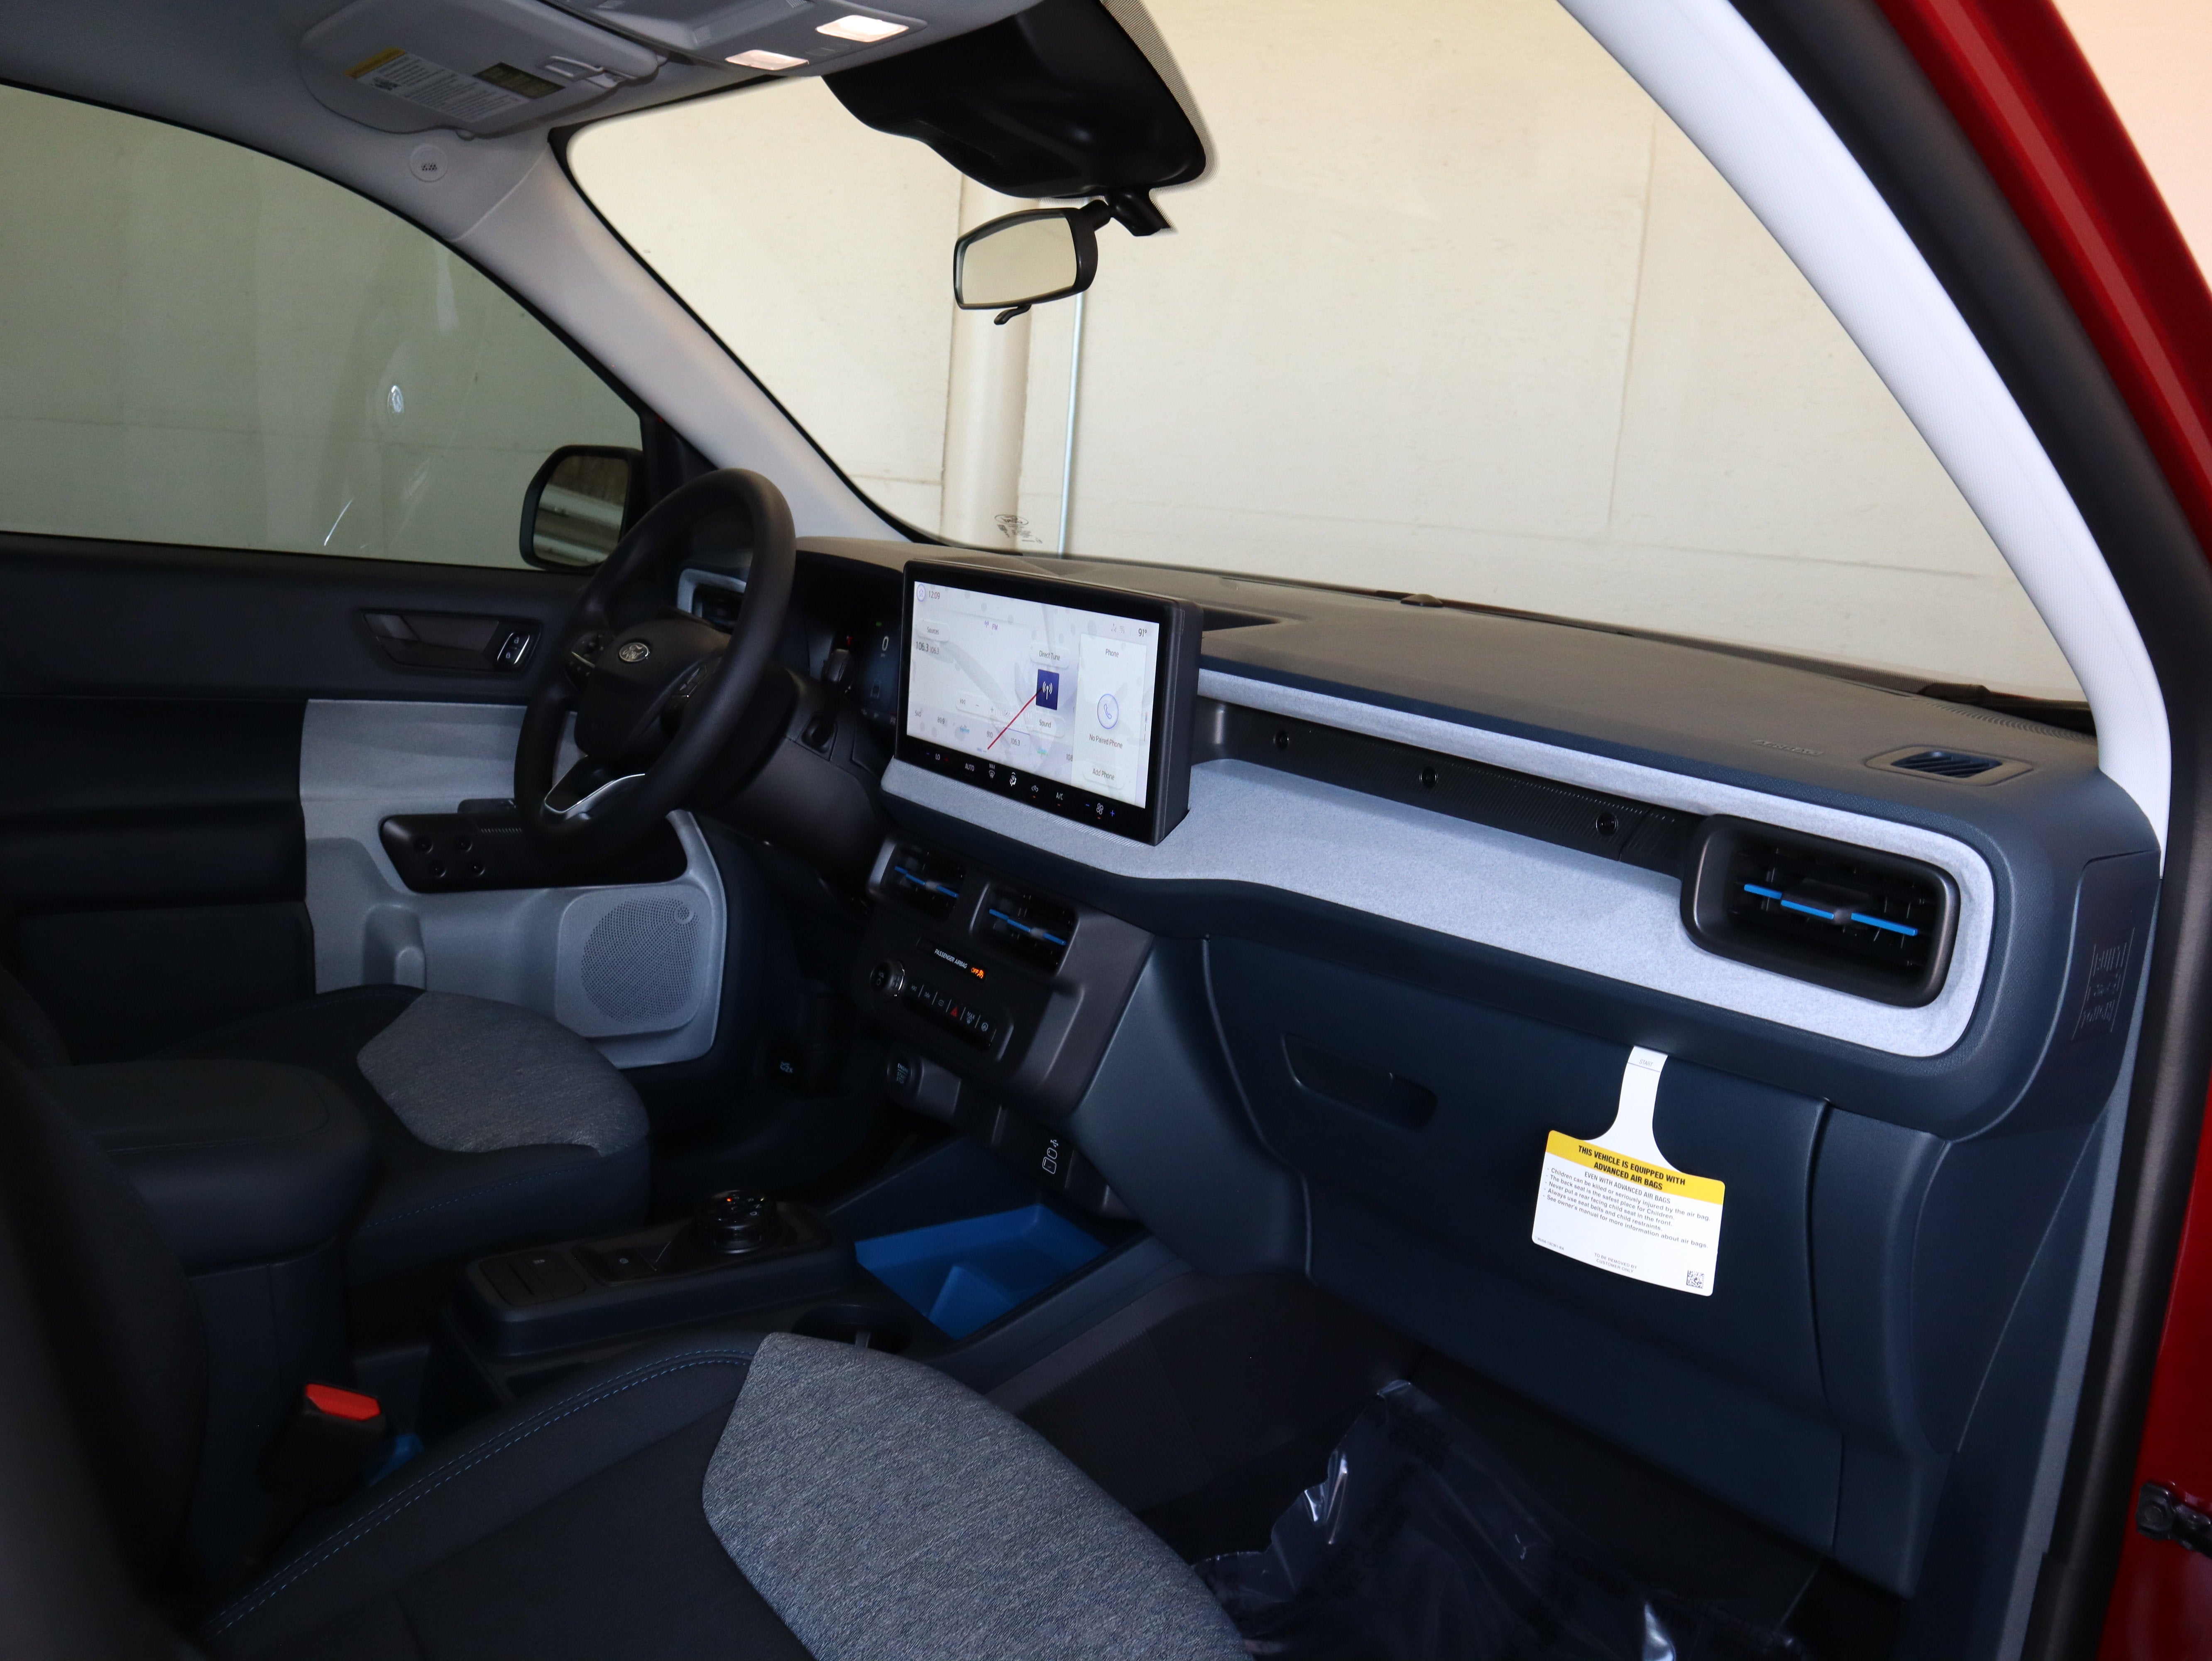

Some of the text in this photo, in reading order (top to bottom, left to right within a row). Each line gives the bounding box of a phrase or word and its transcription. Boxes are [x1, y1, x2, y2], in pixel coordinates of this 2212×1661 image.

[929, 590, 940, 600] 12:09
[927, 627, 939, 635] Sources
[916, 642, 939, 655] 106.3 106.3
[1106, 649, 1119, 657] Phone
[1039, 650, 1050, 659] Direct
[1039, 720, 1051, 728] Sound
[1011, 737, 1020, 746] 106.3
[1096, 735, 1108, 745] Paired
[1109, 739, 1123, 749] Phone
[965, 763, 974, 771] AUTO
[1101, 771, 1115, 781] Phone
[935, 949, 955, 963] PASSENGER
[954, 959, 968, 969] AIRBAG
[1639, 1059, 1653, 1067] START
[1578, 1145, 1686, 1186] THIS VEHICLE IS EQUIPPED WITH
[1594, 1161, 1663, 1190] ADVANCED AIR BAGS
[1584, 1171, 1598, 1181] EVEN
[1599, 1176, 1613, 1186] WITH
[1614, 1181, 1642, 1196] ADVANCED
[1655, 1195, 1671, 1204] BAGS
[1551, 1168, 1573, 1180] Children
[1592, 1183, 1607, 1192] killed
[1615, 1191, 1641, 1205] seriously
[1642, 1200, 1664, 1210] injured
[1697, 1213, 1710, 1222] bag.
[1561, 1178, 1573, 1187] back
[1602, 1194, 1619, 1204] safest
[1620, 1200, 1636, 1209] place
[1647, 1208, 1674, 1220] Children.
[1549, 1181, 1564, 1191] Never
[1591, 1197, 1608, 1208] facing
[1609, 1203, 1623, 1212] child
[1656, 1218, 1672, 1226] front.
[1548, 1188, 1566, 1199] Always
[1590, 1204, 1604, 1213] belts
[1617, 1213, 1631, 1222] child
[1632, 1219, 1662, 1231] restraints.
[1557, 1200, 1578, 1210] owner's
[1579, 1208, 1599, 1218] manual
[1625, 1223, 1659, 1237] information
[1691, 1240, 1708, 1248] bags.
[1596, 1259, 1621, 1269] CUSTOMER
[1608, 1257, 1630, 1267] REMOVED
